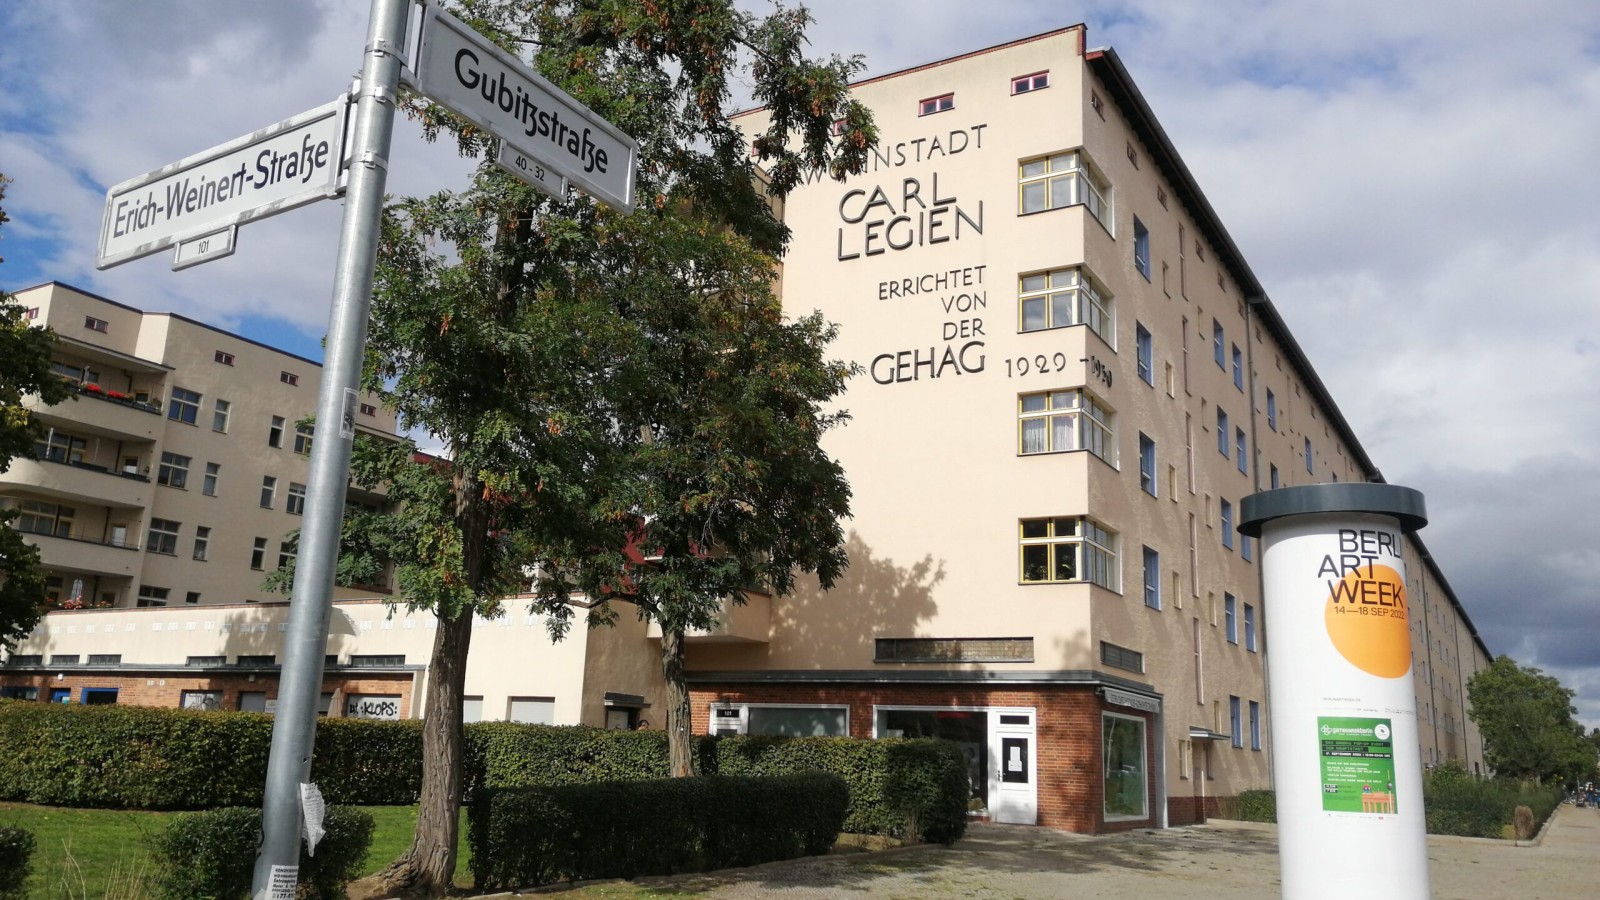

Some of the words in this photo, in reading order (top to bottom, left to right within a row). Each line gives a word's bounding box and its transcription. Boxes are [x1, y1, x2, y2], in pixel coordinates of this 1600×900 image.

[454, 48, 608, 174] Gubitzstraße
[515, 155, 527, 171] 40
[535, 165, 545, 181] 32
[113, 133, 329, 239] Erich-Weinert-Straße
[838, 171, 957, 225] CARL
[837, 200, 984, 261] LEGIEN
[198, 240, 209, 254] 101
[878, 264, 987, 301] ERRICHTET
[941, 290, 987, 314] VON
[943, 318, 986, 341] DER
[870, 340, 986, 385] GEHAG
[1005, 352, 1066, 378] 1929
[1317, 553, 1379, 579] ART
[1327, 579, 1404, 609] WEEK
[1370, 607, 1388, 617] SEP
[1390, 609, 1405, 620] 2022
